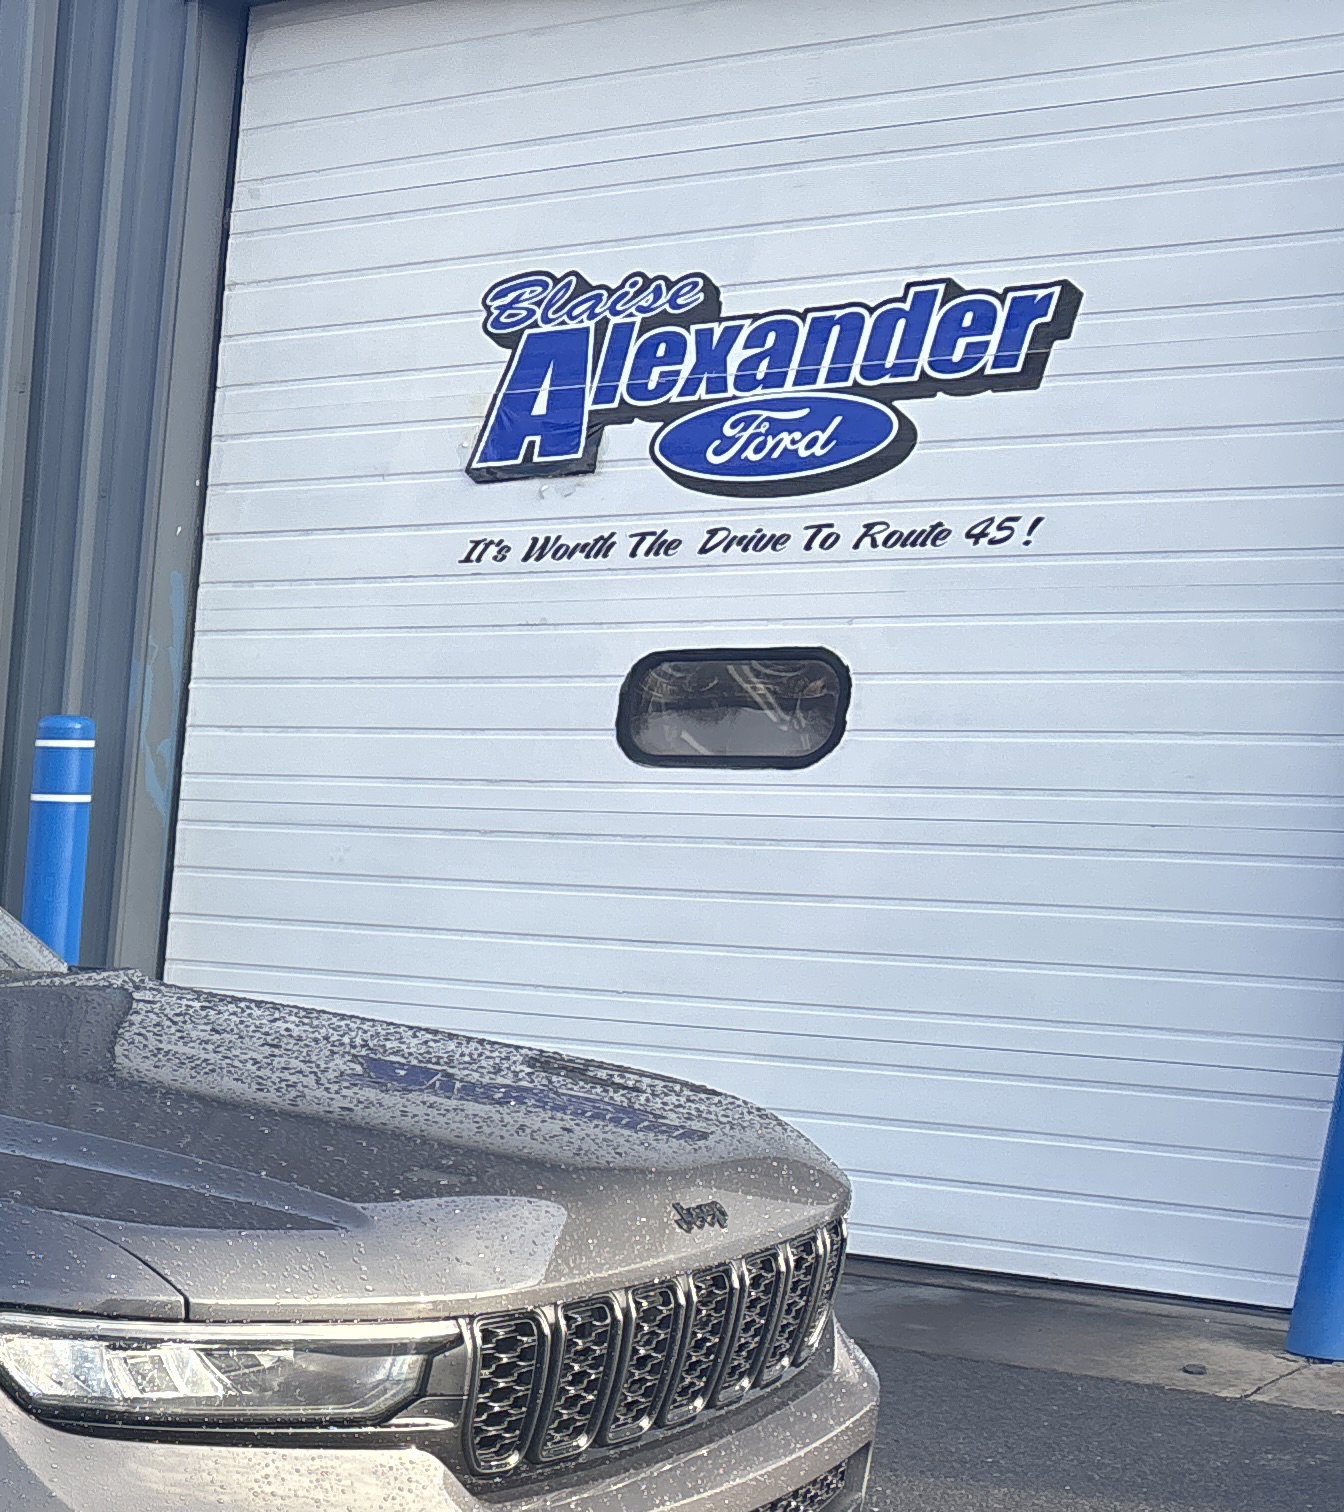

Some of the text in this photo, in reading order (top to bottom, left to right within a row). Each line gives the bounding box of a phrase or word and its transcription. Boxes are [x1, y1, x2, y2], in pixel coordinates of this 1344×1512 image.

[485, 274, 707, 335] Blaise
[469, 280, 1067, 472] Alexander
[707, 408, 840, 466] Ford
[457, 537, 512, 564] It's
[520, 530, 617, 563] Worth
[628, 528, 682, 559] The
[696, 525, 792, 555] Drive
[802, 522, 841, 551] To
[851, 520, 953, 550] Route
[672, 1200, 729, 1234] Jeep
